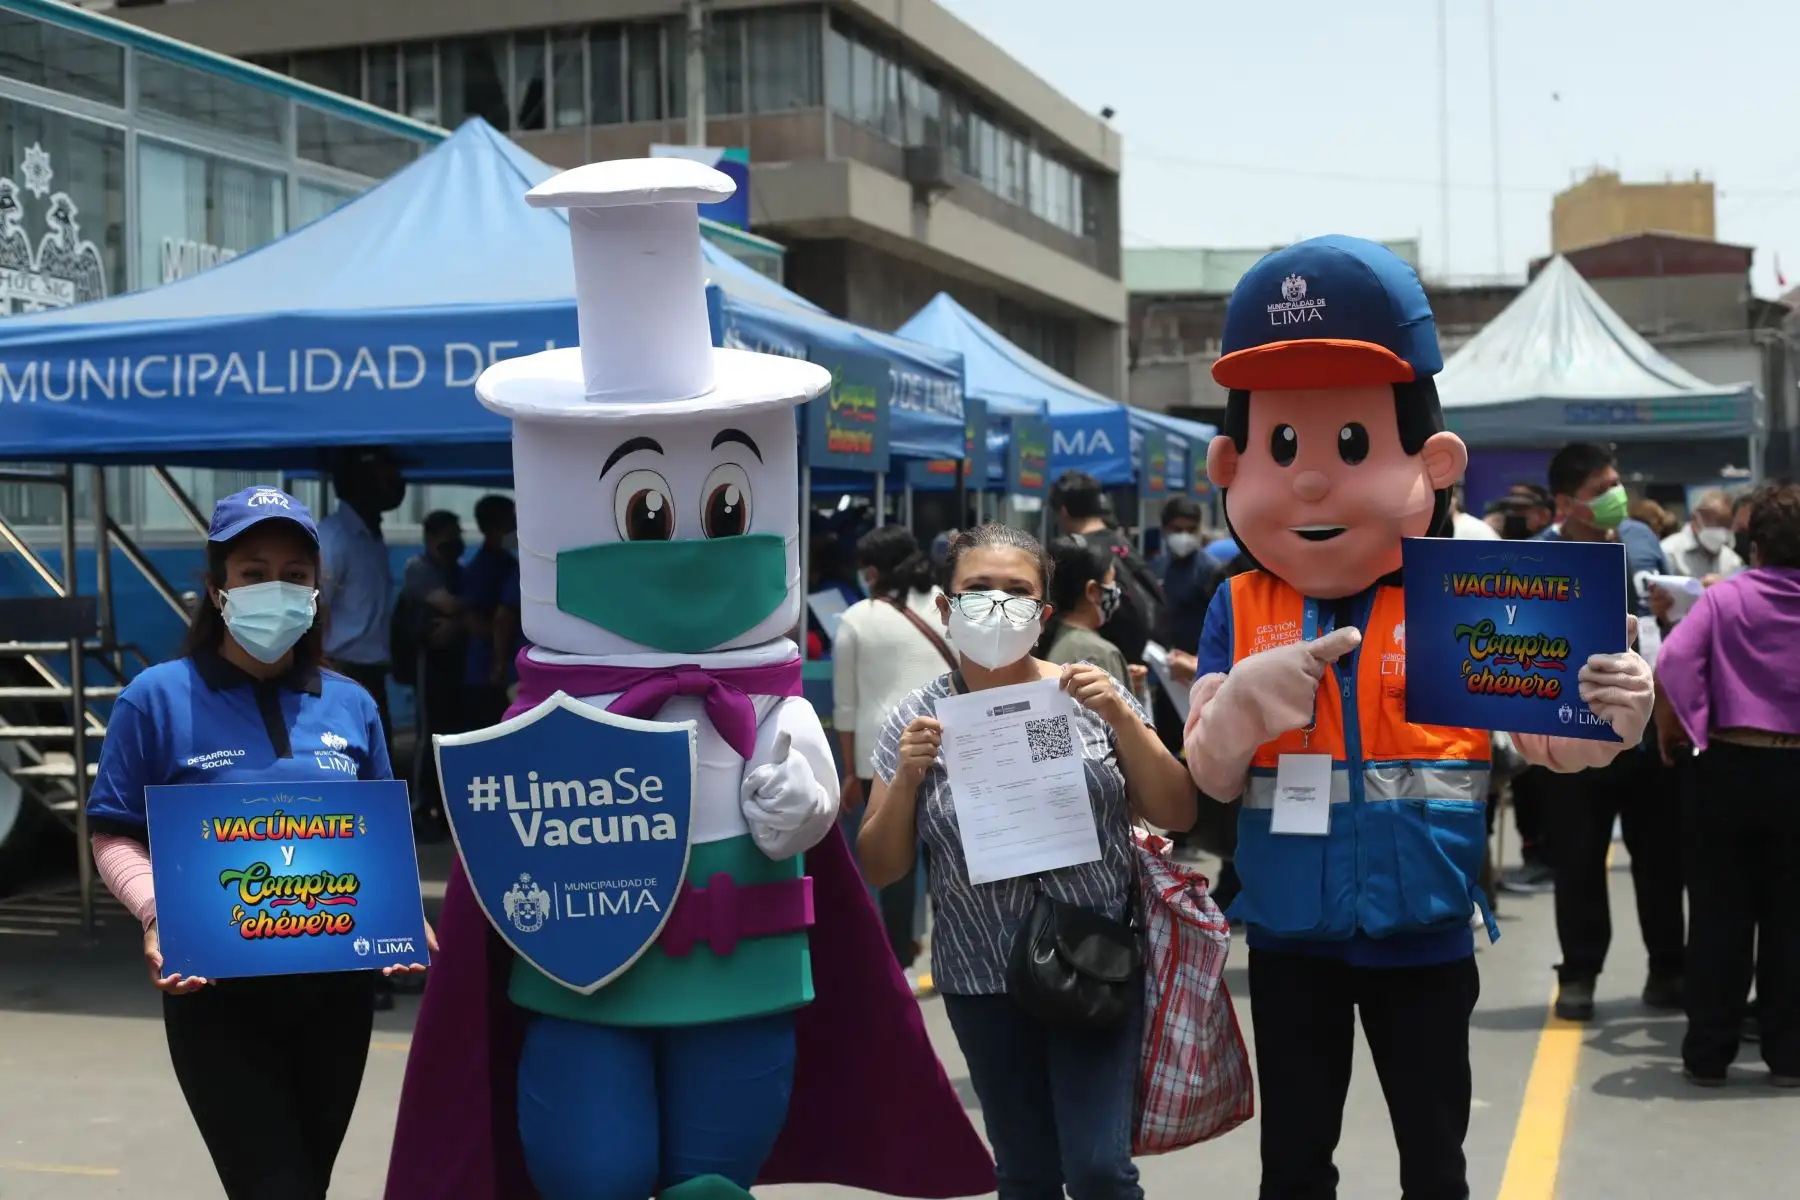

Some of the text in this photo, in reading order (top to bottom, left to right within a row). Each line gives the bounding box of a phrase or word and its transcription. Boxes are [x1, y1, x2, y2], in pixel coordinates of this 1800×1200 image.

[1267, 298, 1325, 311] MUNICIPALIDAD DE
[1271, 308, 1323, 325] LIMA
[0, 345, 426, 403] MUNICIPALIDAD
[1053, 428, 1115, 456] MA
[248, 495, 290, 510] LIMA
[1452, 568, 1570, 600] VACÚNATE
[1454, 618, 1571, 663] Compra
[1466, 666, 1562, 700] chévere
[187, 750, 245, 766] DESARROLLO
[202, 760, 234, 770] SOCIAL
[316, 757, 357, 776] LIMA
[467, 767, 663, 811] #LimaSe
[212, 810, 354, 842] VACÚNATE
[508, 811, 677, 847] Vacuna
[219, 862, 358, 904] Compra
[564, 878, 657, 891] MUNICIPALIDAD DE
[566, 889, 661, 918] LIMA
[240, 909, 354, 941] chévere
[377, 942, 415, 954] LIMA
